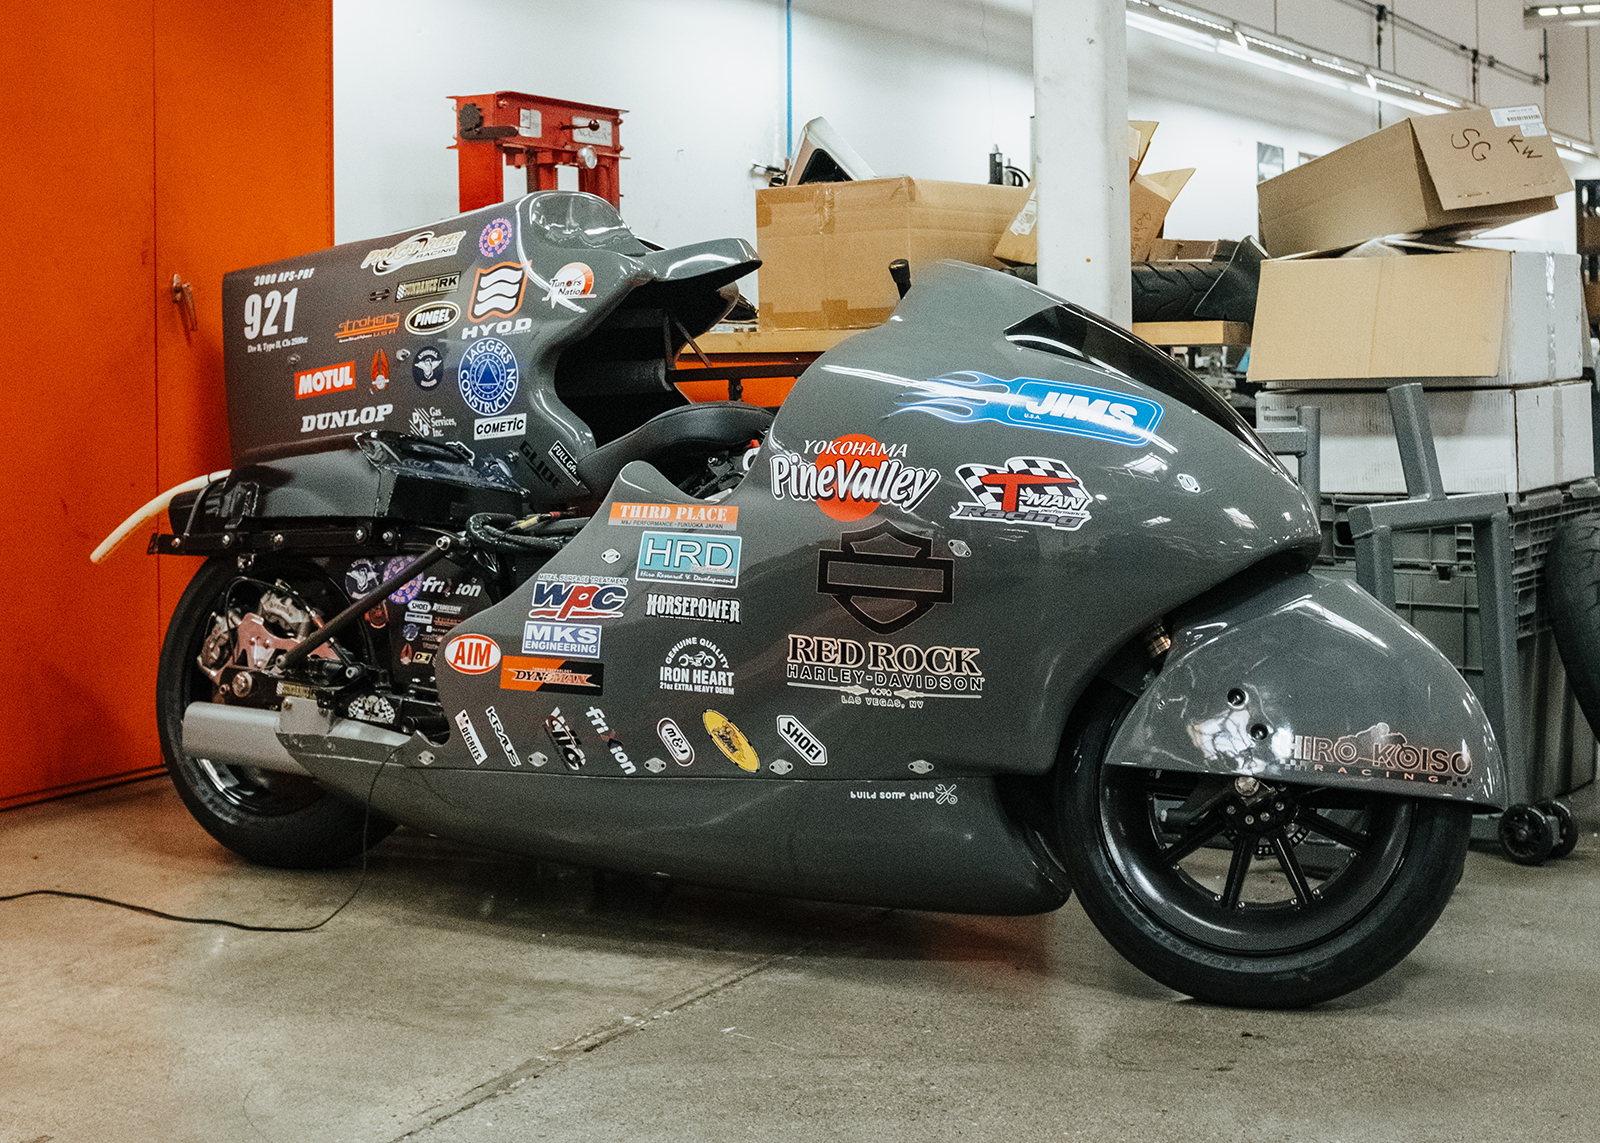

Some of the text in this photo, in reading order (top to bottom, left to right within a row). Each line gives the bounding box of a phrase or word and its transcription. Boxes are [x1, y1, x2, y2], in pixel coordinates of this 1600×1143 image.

[253, 273, 277, 287] 3000
[438, 276, 457, 288] RK
[558, 287, 586, 296] Nation
[243, 287, 298, 340] 921
[413, 308, 451, 327] PINGEL
[461, 317, 533, 340] HYOD
[465, 340, 513, 365] JAGGERS
[298, 366, 353, 395] MOTUL
[460, 368, 516, 414] CONSTRUCTION
[301, 403, 393, 432] DUNLOP
[429, 407, 442, 417] Gas
[1024, 391, 1139, 429] JIMS
[476, 417, 524, 435] COMETIC
[552, 445, 568, 464] FULL
[803, 439, 909, 458] YOKOHAMA
[620, 505, 728, 522] THIRD PLACE
[958, 505, 1084, 528] Racing
[644, 538, 734, 570] HRD
[693, 573, 735, 585] Development
[645, 593, 741, 623] HORSEPOWER
[525, 625, 598, 644] MKS
[453, 641, 492, 667] AIM
[525, 641, 597, 654] ENGINEERING
[665, 637, 730, 669] GENUINE QUALITY
[786, 634, 983, 676] RED ROCK
[660, 666, 735, 687] IRON HEART
[786, 663, 984, 691] HARLEY-DAVIDSON
[659, 682, 735, 695] 21oz EXTRA HEAVY DENIM
[841, 695, 924, 709] LAS VEGAS, NV
[461, 726, 482, 760] DEGREES
[782, 720, 822, 761] SHOEI
[1290, 734, 1473, 776] HIRO KOISO
[1314, 763, 1440, 783] RACING
[850, 791, 877, 800] build
[909, 791, 935, 801] thing
